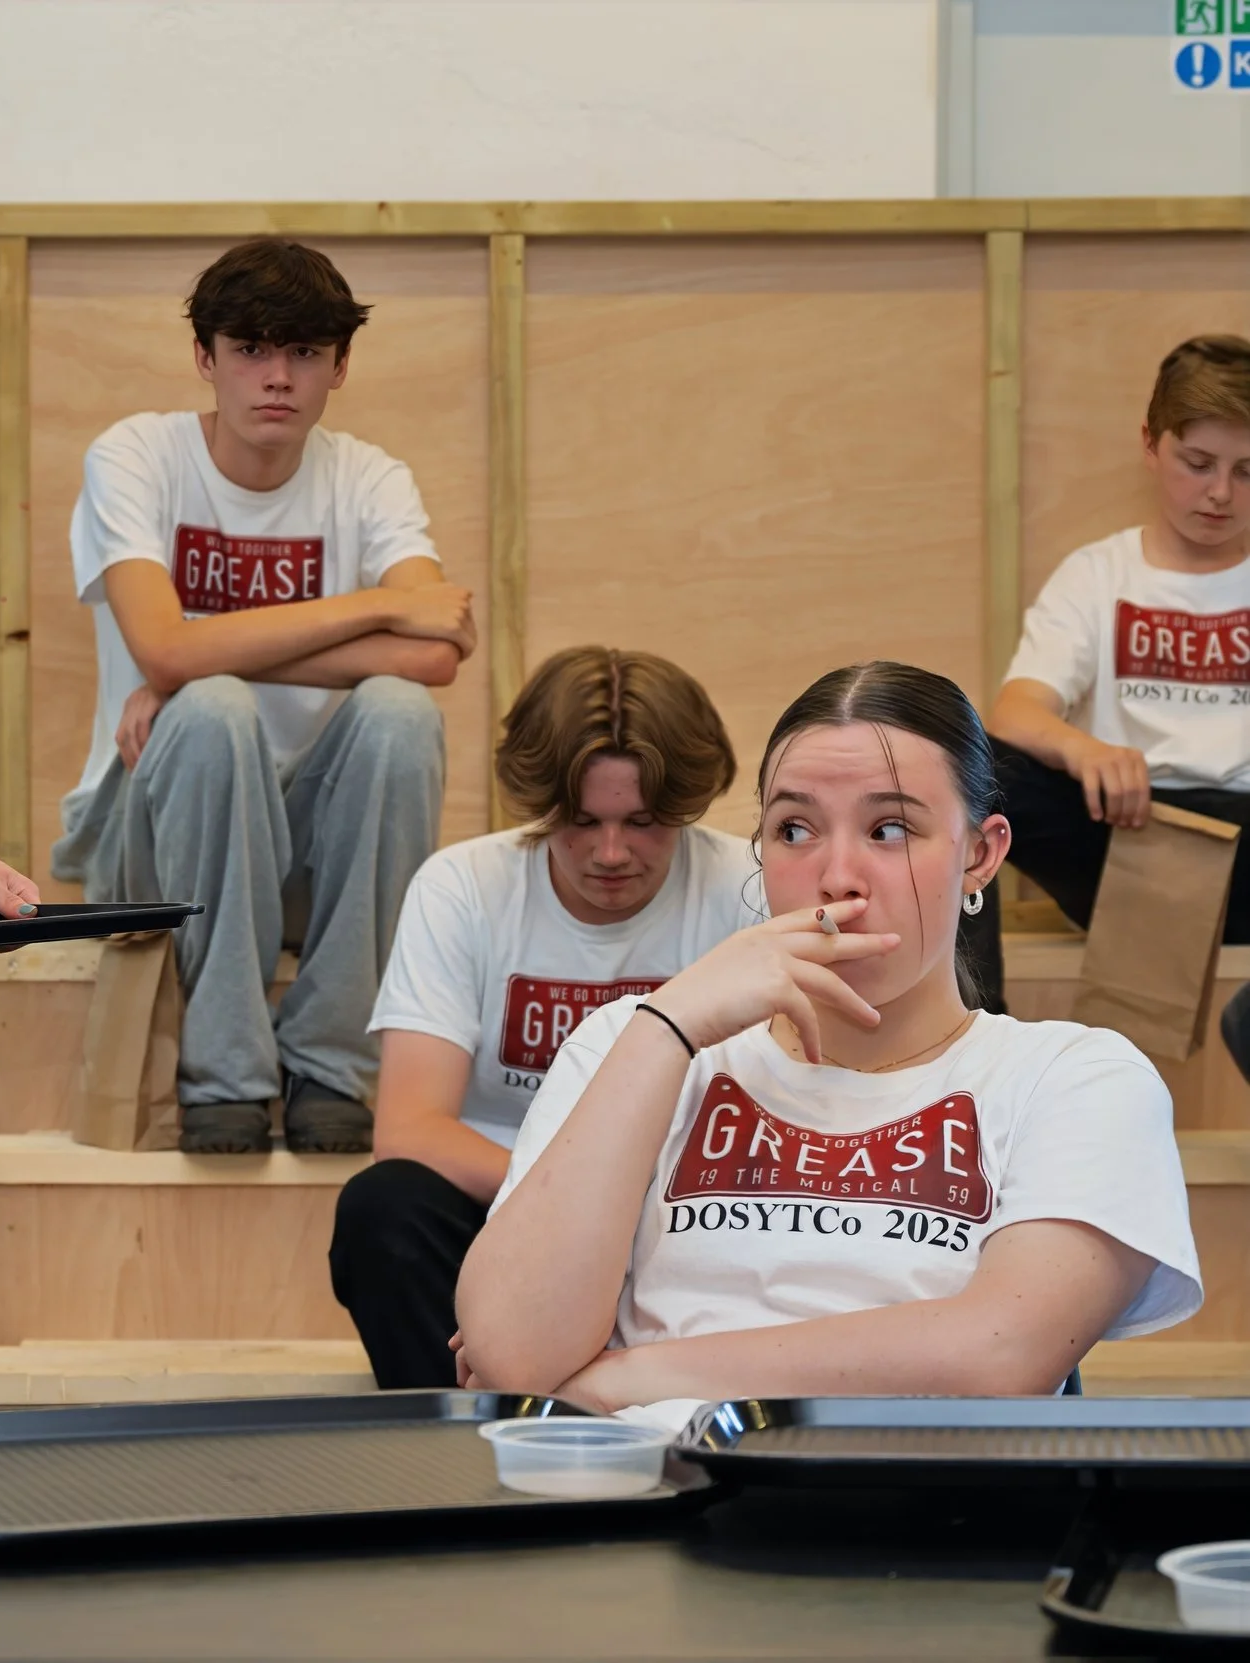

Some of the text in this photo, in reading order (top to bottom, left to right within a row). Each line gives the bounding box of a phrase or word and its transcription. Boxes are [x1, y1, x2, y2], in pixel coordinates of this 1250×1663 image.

[186, 548, 317, 600] GREASE
[1130, 620, 1250, 667] GREAS
[550, 986, 568, 1000] WE
[574, 988, 589, 1002] GO
[702, 1103, 970, 1177] GREASE
[752, 1103, 922, 1148] WE GO TOGETHER
[699, 1168, 970, 1205] 19 THE MUSICAL 59
[667, 1202, 972, 1252] DOSYTCo 2025
